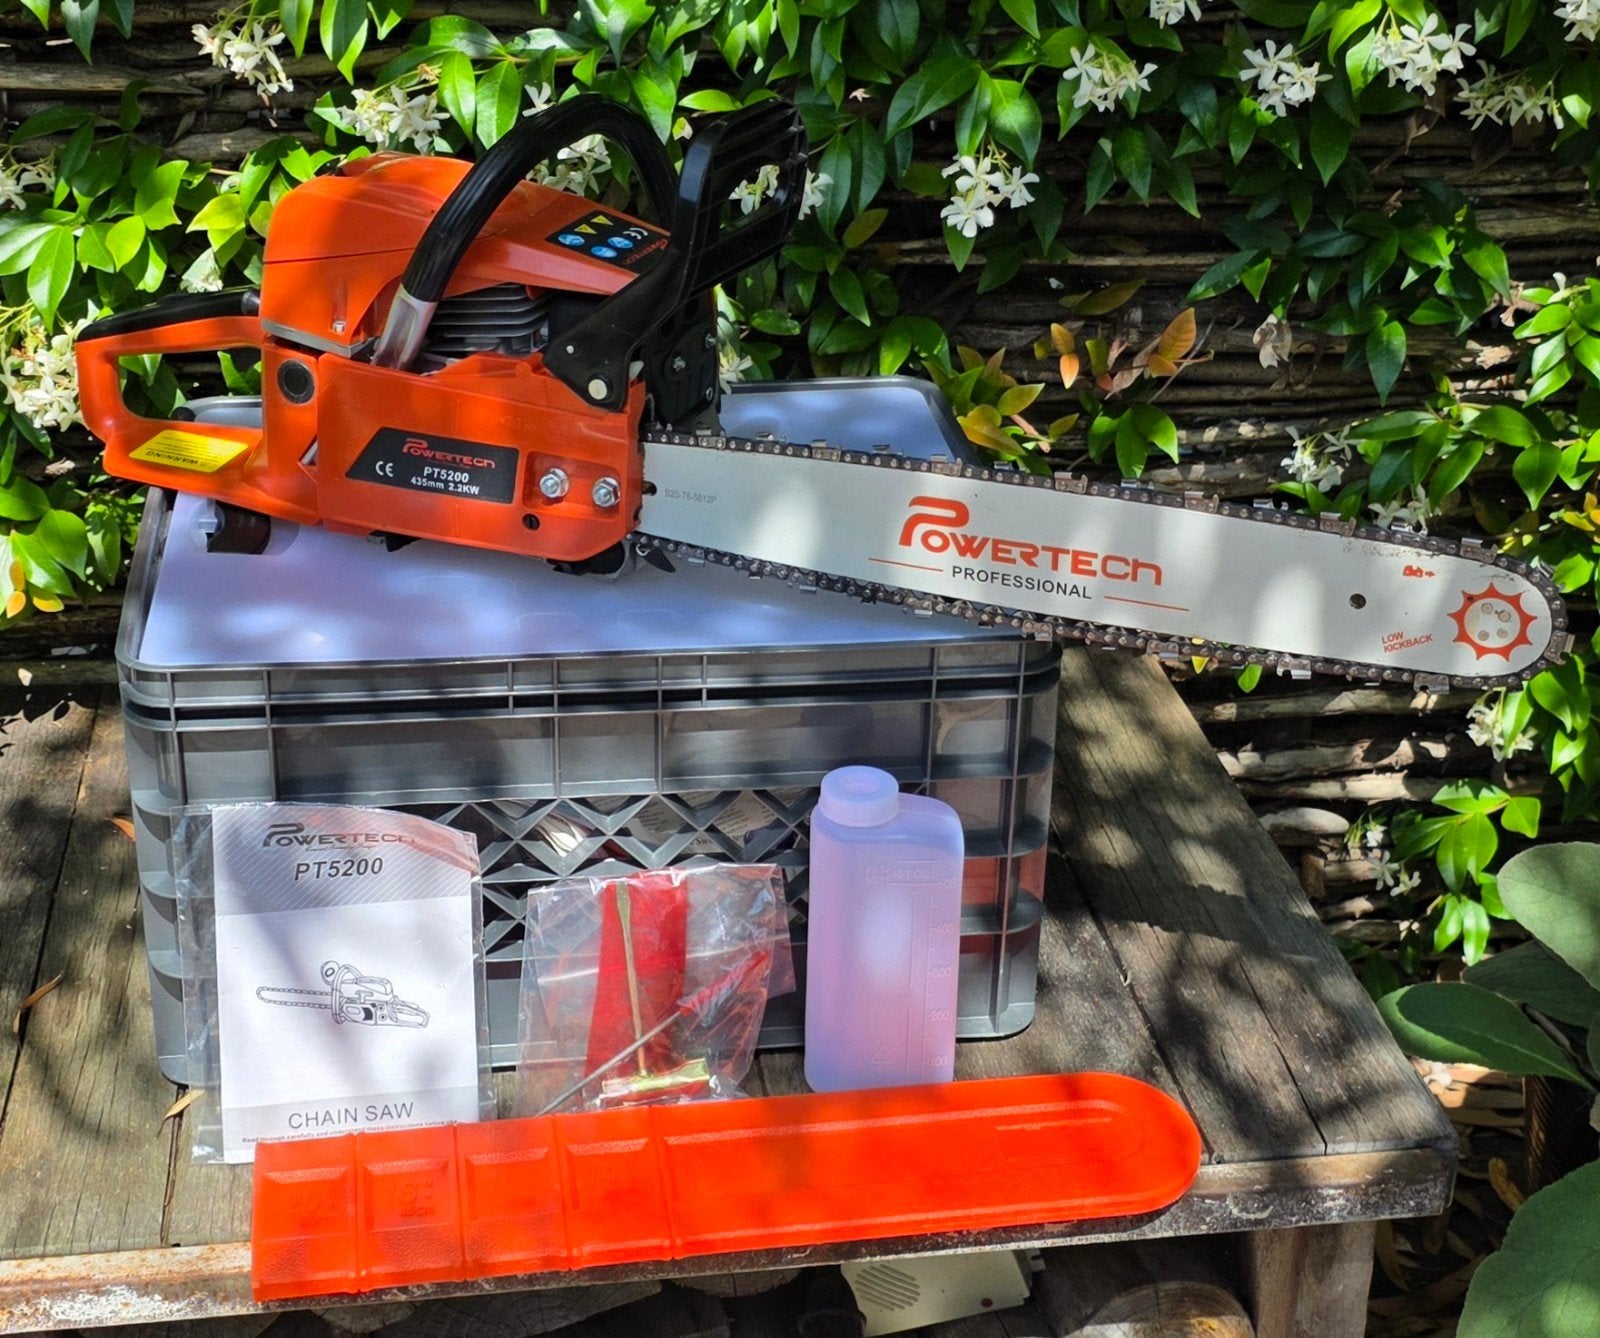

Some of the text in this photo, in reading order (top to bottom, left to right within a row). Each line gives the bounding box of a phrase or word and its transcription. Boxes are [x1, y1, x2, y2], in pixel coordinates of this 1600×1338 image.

[145, 451, 199, 465] WARNING
[402, 437, 496, 469] POWERTECH
[423, 465, 470, 483] PT5200
[410, 476, 480, 495] 435mm 2.2KW
[898, 495, 1163, 586] POWERTECH
[951, 565, 1093, 599] PROFESSIONAL
[1381, 631, 1403, 644] LOW
[1383, 633, 1434, 653] KICKBACK
[294, 857, 383, 881] PT5200
[288, 1101, 415, 1130] CHAIN SAW
[286, 1130, 314, 1141] carefully
[316, 1128, 328, 1137] and
